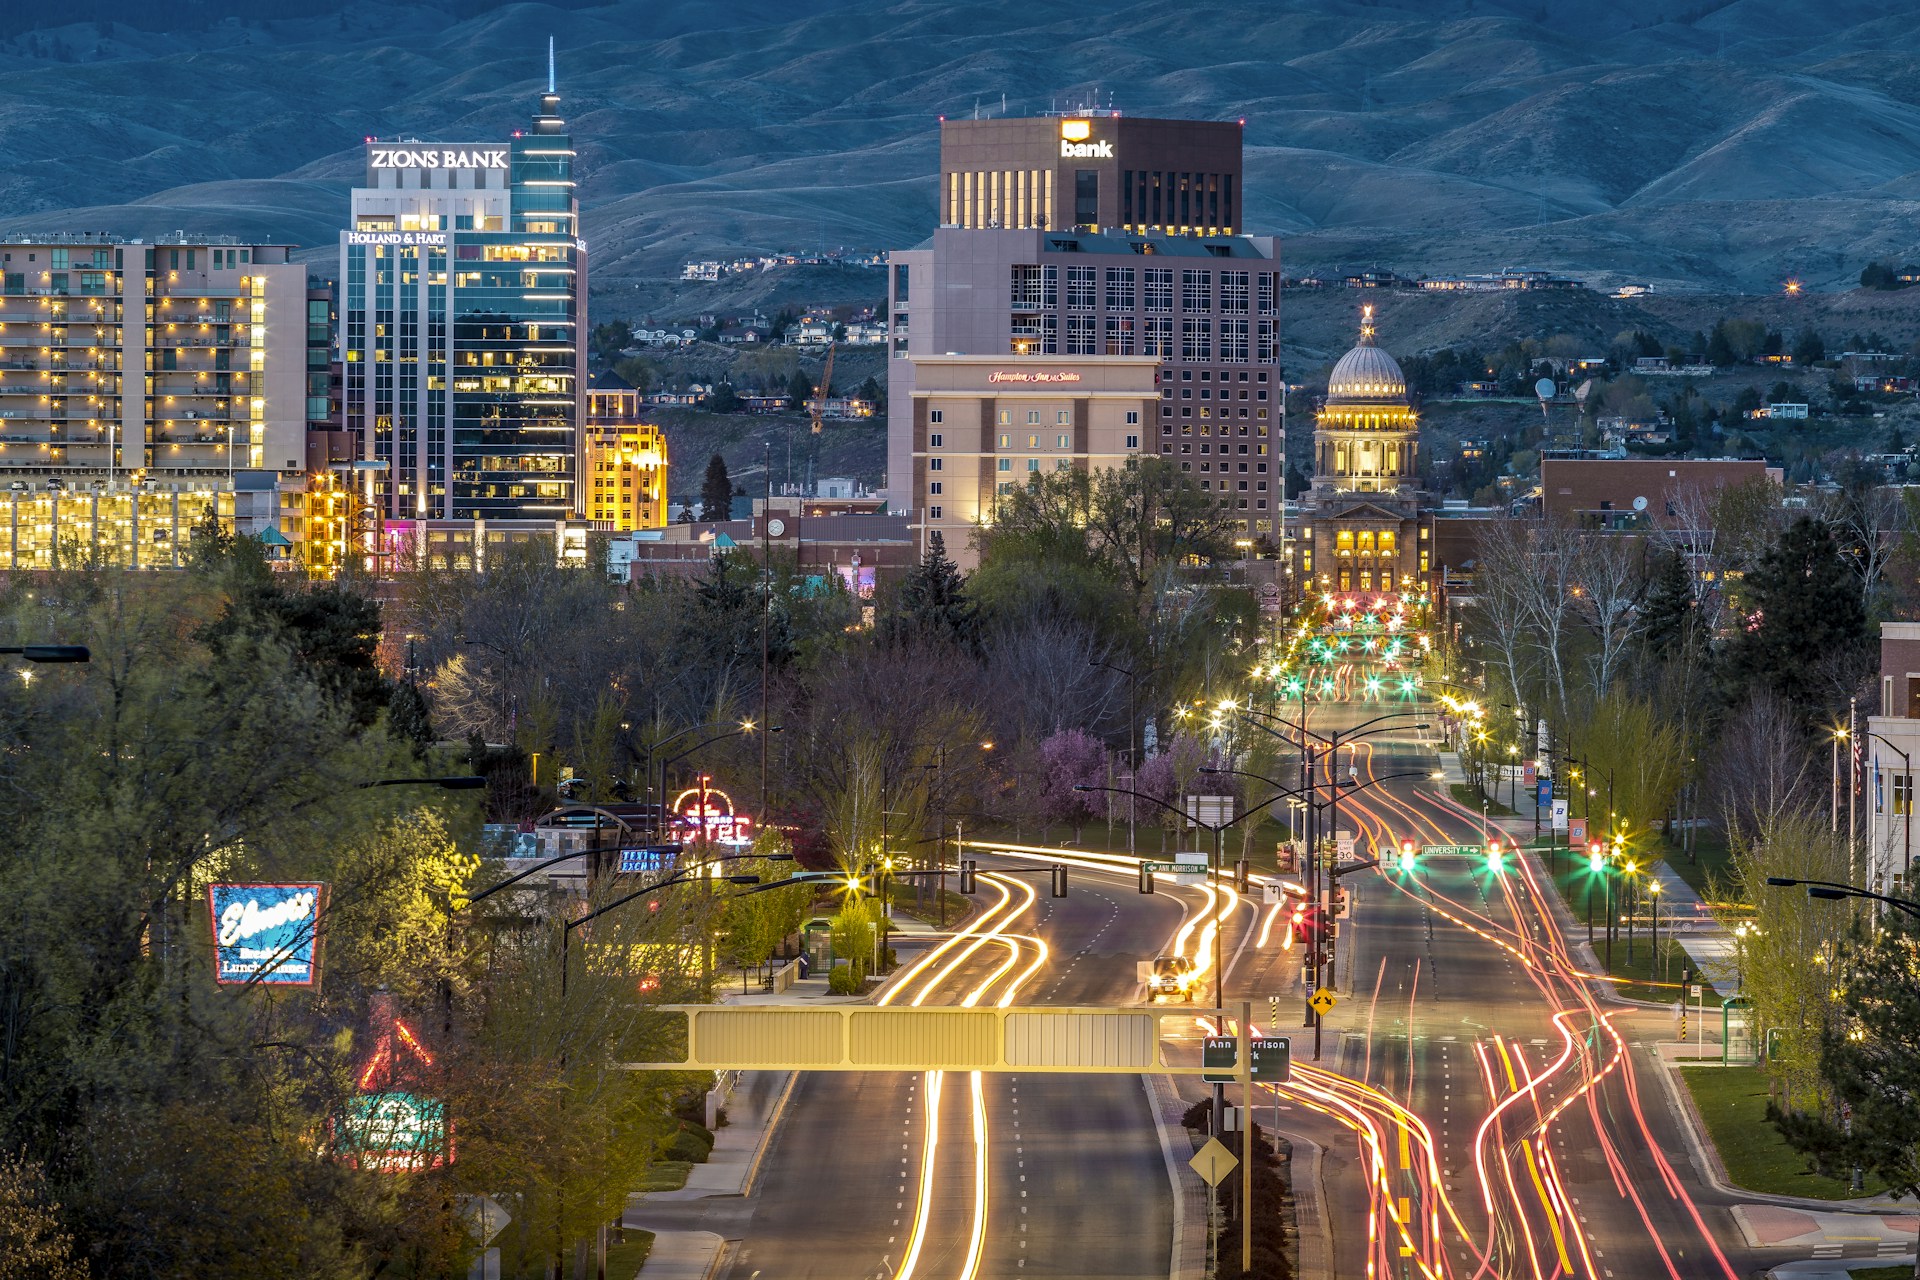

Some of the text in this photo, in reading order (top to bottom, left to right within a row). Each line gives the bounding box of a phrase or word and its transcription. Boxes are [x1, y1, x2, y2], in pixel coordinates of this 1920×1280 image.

[1061, 140, 1113, 157] bank
[371, 149, 509, 168] ZIONS BANK
[348, 232, 447, 244] HOLLAND & HART
[988, 371, 1031, 383] Hampton
[1031, 372, 1052, 382] Inn
[1056, 372, 1080, 381] Suites
[1555, 807, 1565, 815] B
[1572, 827, 1583, 837] B
[1424, 846, 1461, 855] UNIVERSITY
[1339, 851, 1352, 860] 30
[1158, 864, 1170, 872] ANN
[1171, 865, 1199, 873] MORRISON
[1209, 1040, 1285, 1049] Ann rrison
